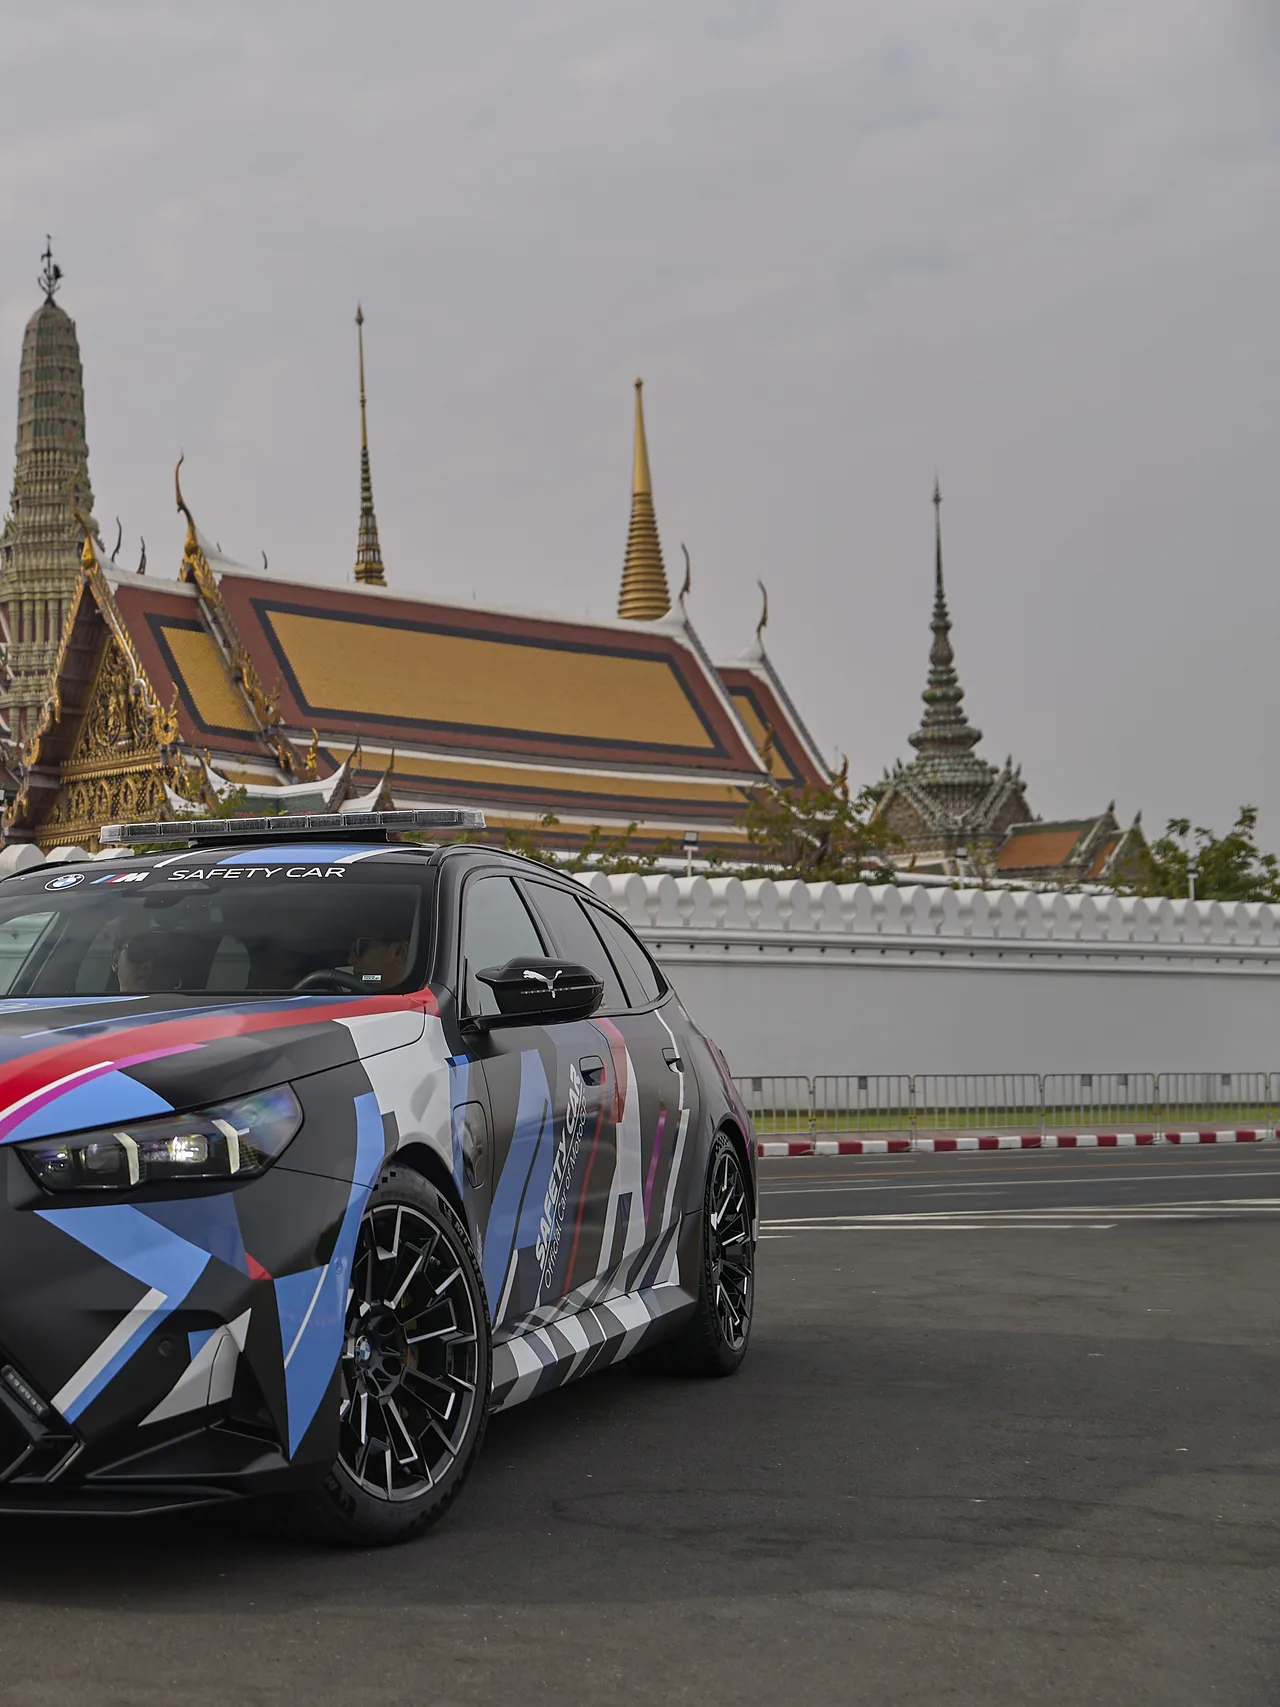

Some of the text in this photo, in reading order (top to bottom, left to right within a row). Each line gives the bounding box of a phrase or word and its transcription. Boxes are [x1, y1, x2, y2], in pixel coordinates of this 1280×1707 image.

[111, 872, 150, 882] M
[168, 867, 346, 880] SAFETY CAR
[535, 1063, 580, 1271] SAFETY CAR
[545, 1219, 562, 1288] Official
[558, 1188, 567, 1220] Car
[565, 1165, 572, 1189] of
